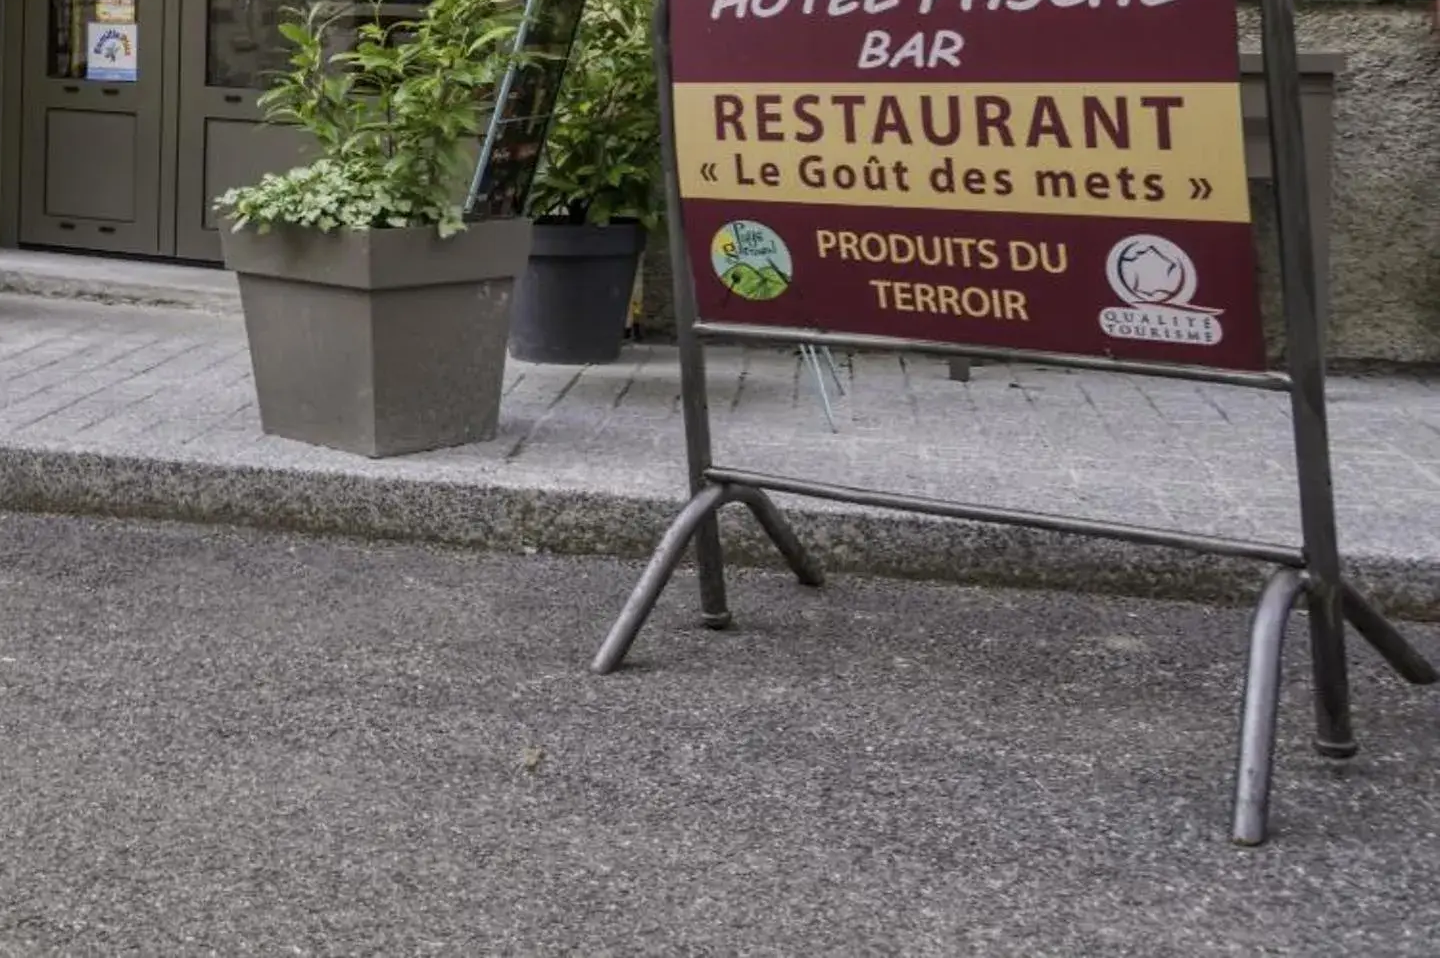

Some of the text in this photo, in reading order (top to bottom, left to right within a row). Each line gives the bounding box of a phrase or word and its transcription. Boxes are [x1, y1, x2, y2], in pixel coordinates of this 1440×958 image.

[857, 30, 966, 71] BAR
[714, 93, 1186, 152] RESTAURANT
[735, 154, 781, 187] Le
[798, 153, 910, 193] Goût
[929, 156, 1014, 197] des
[1035, 164, 1166, 201] mets
[816, 229, 1069, 275] PRODUITS DU
[869, 279, 1029, 322] TERROIR
[1104, 323, 1214, 343] TOURISME
